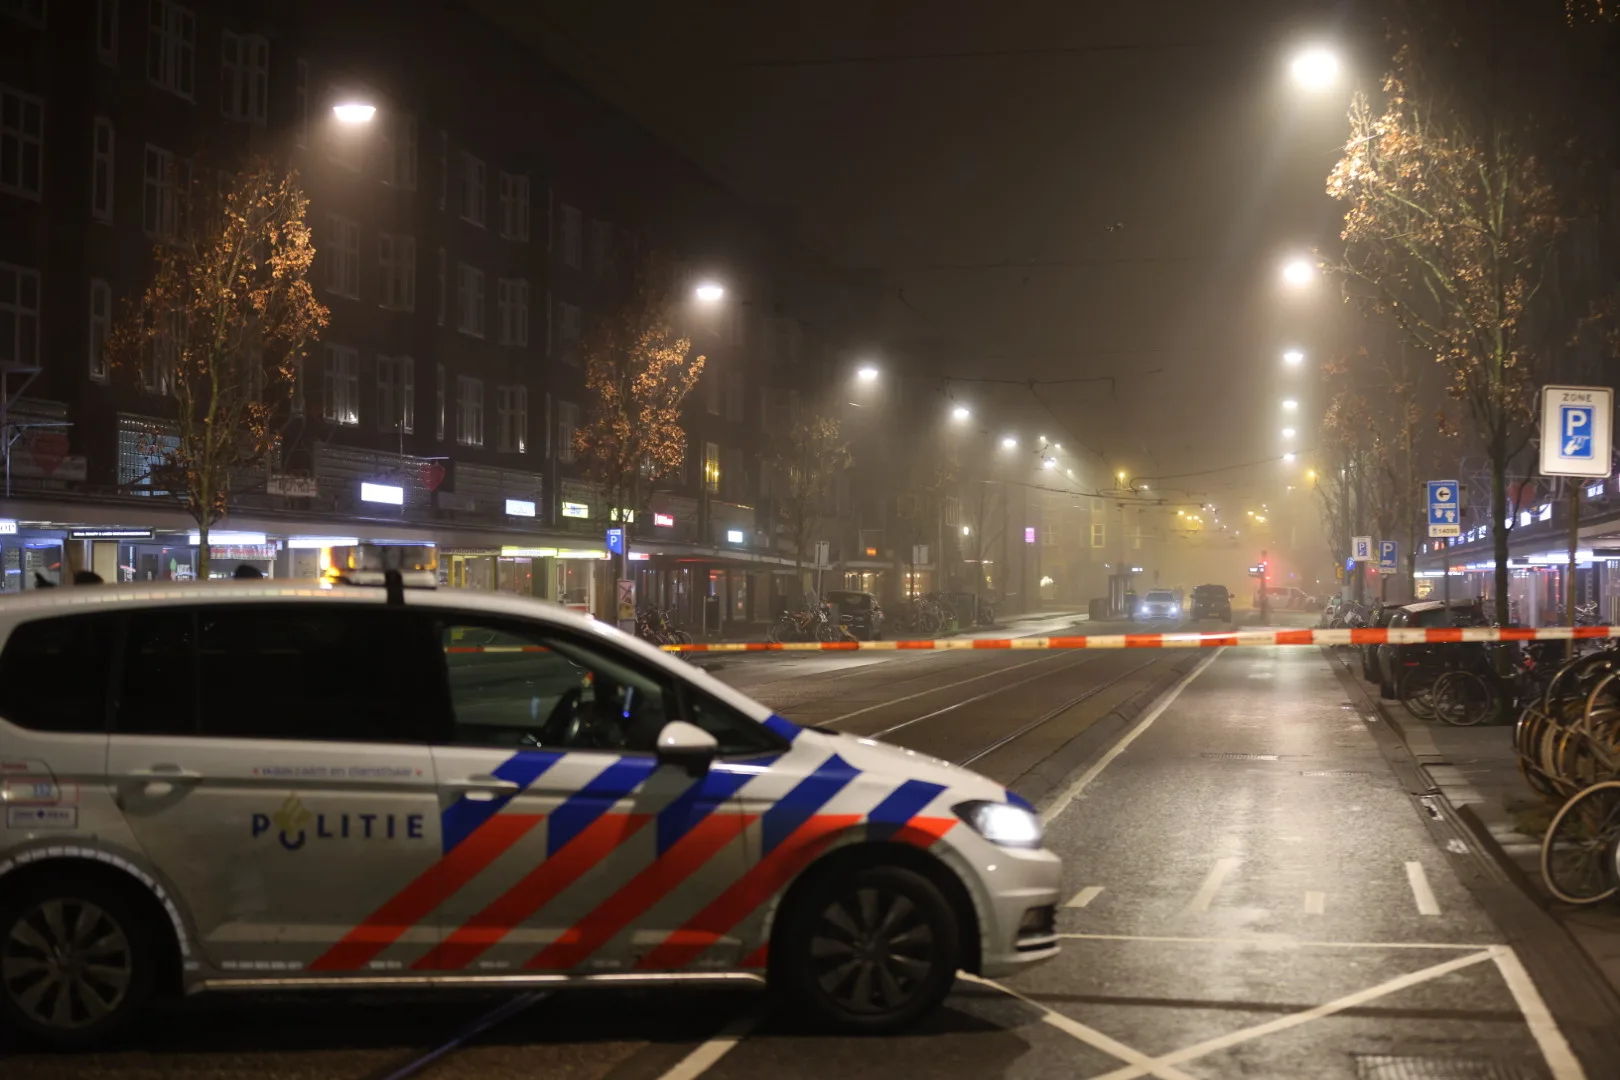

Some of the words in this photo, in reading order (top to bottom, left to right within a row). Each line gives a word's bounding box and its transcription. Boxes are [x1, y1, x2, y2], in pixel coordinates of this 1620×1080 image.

[1562, 393, 1593, 402] ZONE
[1566, 409, 1588, 436] P
[610, 536, 618, 547] P
[1382, 543, 1393, 557] P
[252, 813, 424, 851] POLITIE
